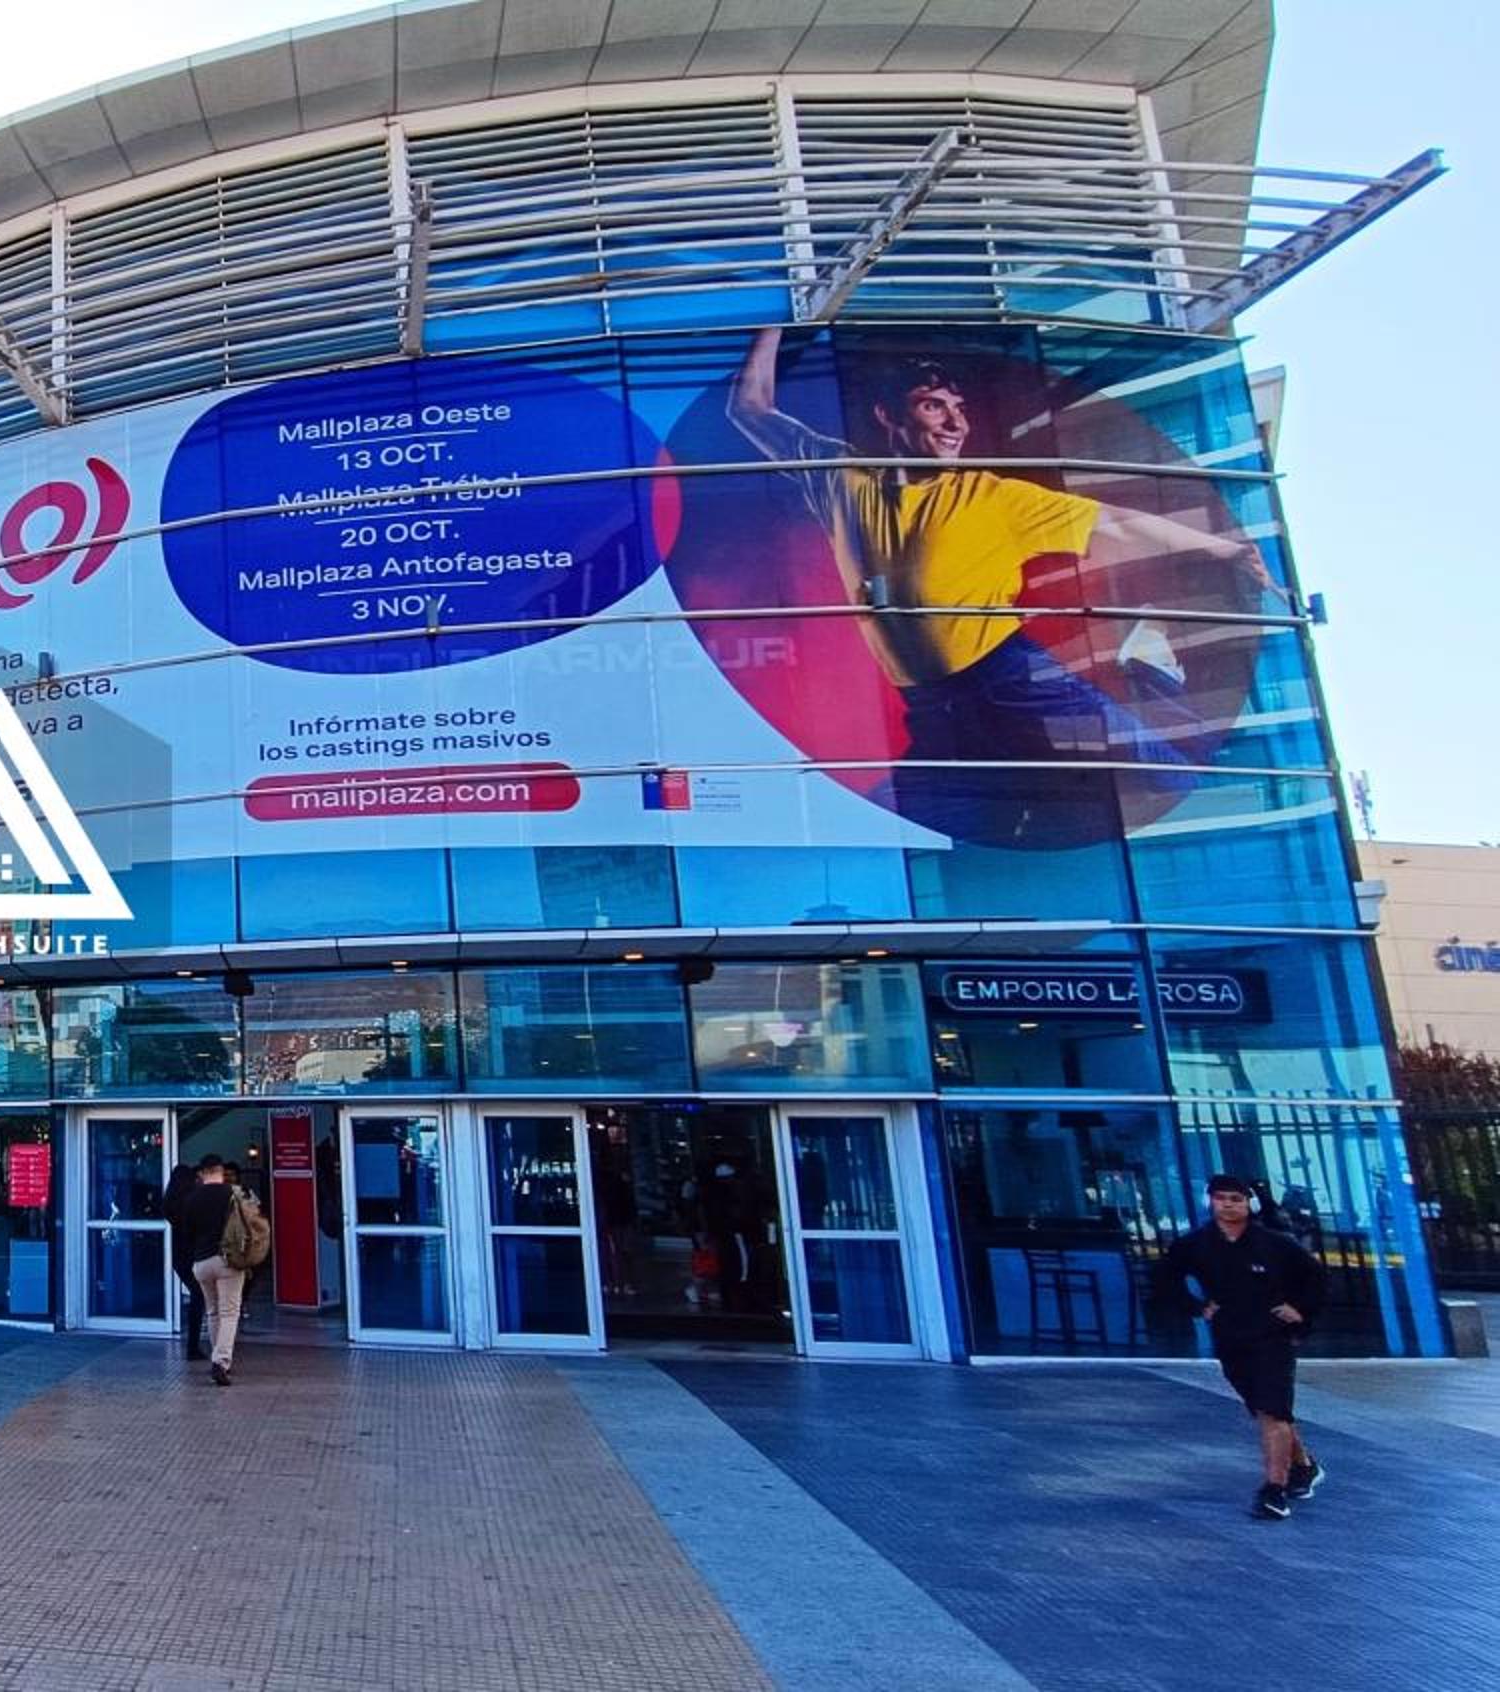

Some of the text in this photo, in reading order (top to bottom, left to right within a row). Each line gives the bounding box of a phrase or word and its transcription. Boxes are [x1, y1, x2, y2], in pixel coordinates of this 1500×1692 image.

[278, 403, 512, 443] Mallplaza Oeste
[337, 441, 453, 471] 13 OCT.
[277, 471, 522, 518] Mallplaza Trébol
[340, 519, 460, 548] 20 OCT.
[238, 549, 573, 592] Mallplaza Antofagasta
[352, 600, 370, 620] 3
[289, 707, 516, 737] Infórmate sobre
[259, 728, 552, 761] los castings masivos
[291, 778, 530, 811] mallplaza.com
[957, 980, 1098, 1001] EMPORIO
[1155, 983, 1238, 1003] ROSA
